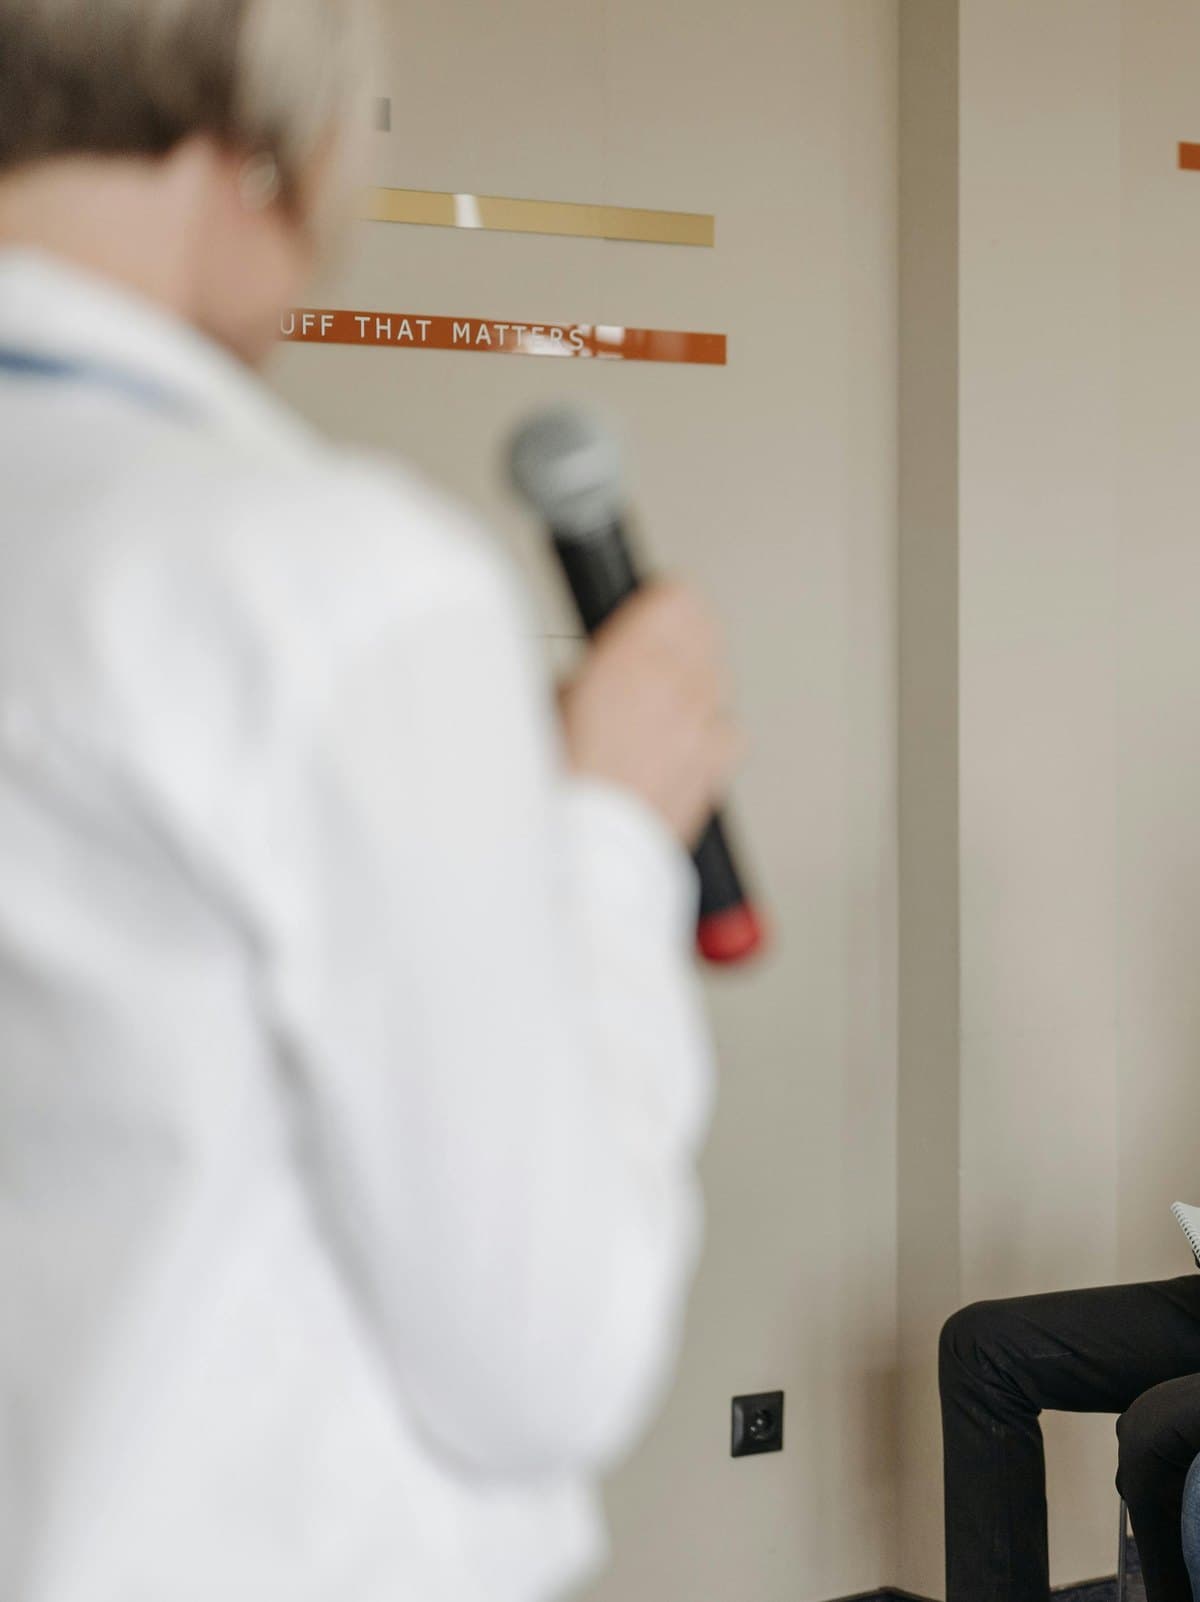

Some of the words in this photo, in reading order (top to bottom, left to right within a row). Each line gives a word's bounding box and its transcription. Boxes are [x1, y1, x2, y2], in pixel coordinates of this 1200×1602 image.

[280, 313, 335, 337] UFF
[354, 315, 433, 342] THAT
[452, 321, 586, 351] MATTERS
